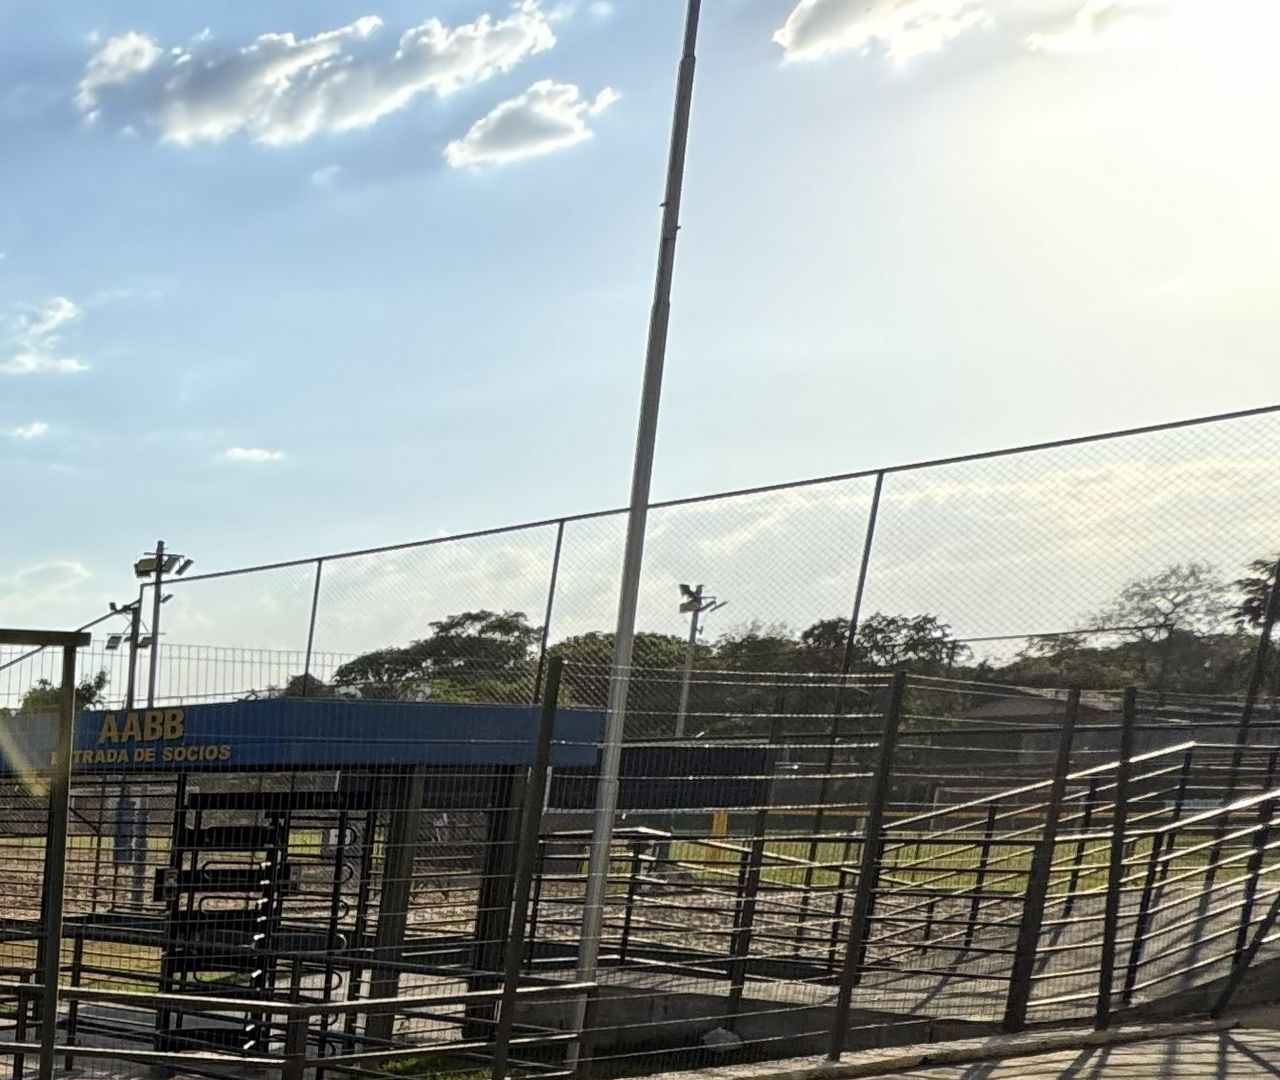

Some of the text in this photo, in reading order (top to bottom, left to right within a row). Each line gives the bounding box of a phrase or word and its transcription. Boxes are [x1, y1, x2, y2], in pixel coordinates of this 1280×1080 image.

[98, 709, 186, 743] AABB
[50, 749, 129, 765] ETRADA
[134, 748, 156, 762] DE
